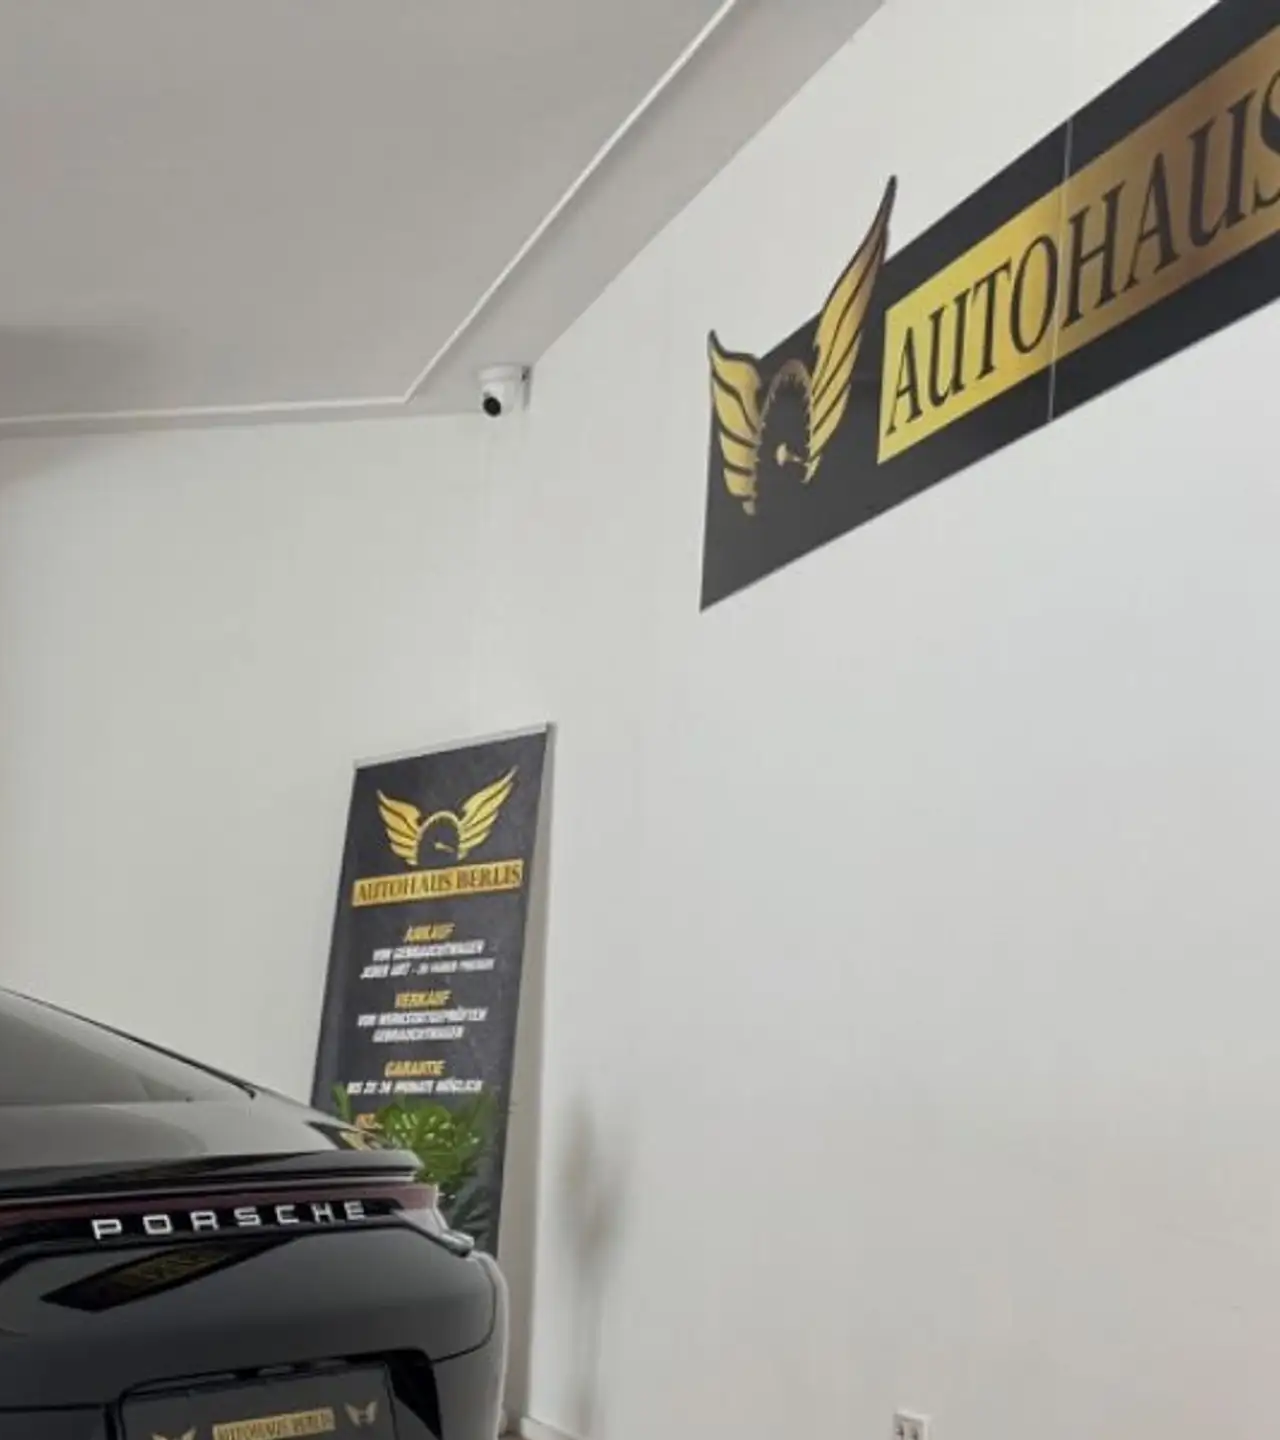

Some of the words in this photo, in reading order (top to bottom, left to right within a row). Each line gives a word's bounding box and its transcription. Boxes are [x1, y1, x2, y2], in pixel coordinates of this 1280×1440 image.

[358, 870, 452, 901] AUTOHAUS
[384, 1060, 446, 1078] GARANTIE
[91, 1199, 366, 1240] PORSCHE
